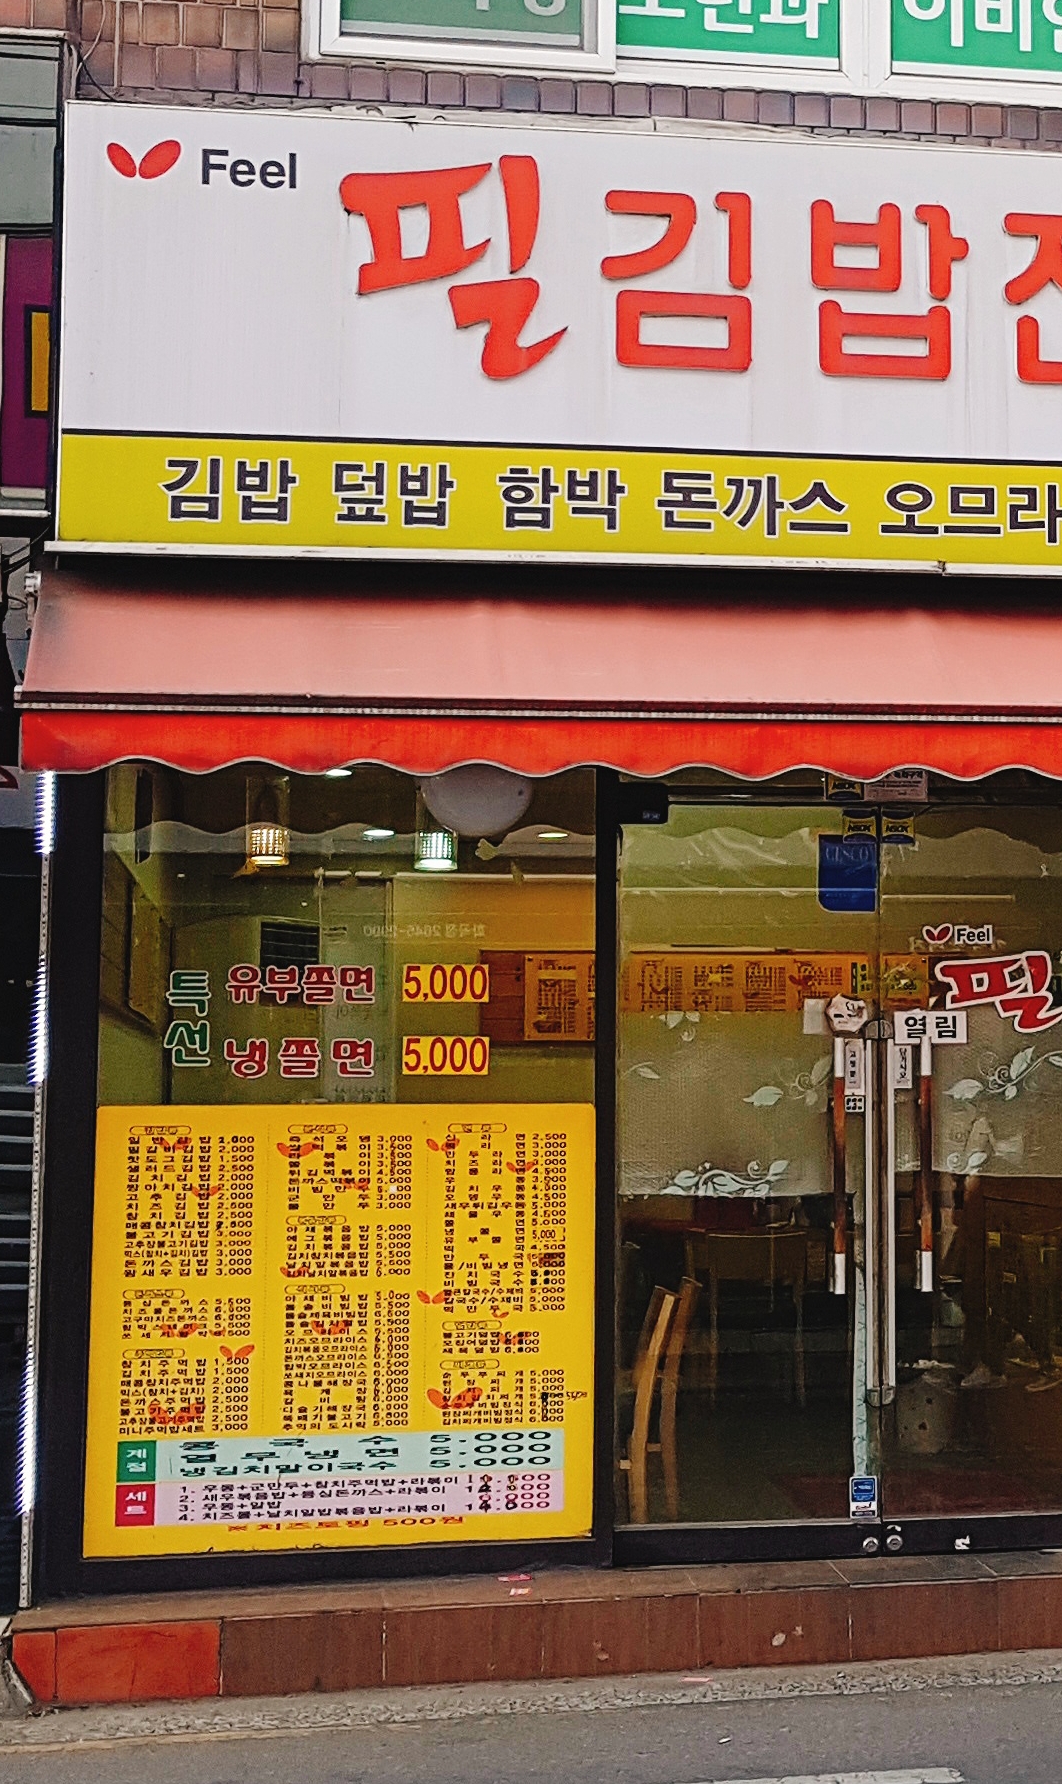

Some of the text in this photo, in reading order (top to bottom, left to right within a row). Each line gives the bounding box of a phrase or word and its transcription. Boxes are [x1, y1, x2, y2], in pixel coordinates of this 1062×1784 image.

[200, 148, 298, 190] Feel
[338, 154, 568, 380] 필
[158, 457, 299, 522] 김밥
[333, 461, 456, 528] 덮밥
[498, 466, 626, 530] 함박
[654, 469, 851, 538] 돈까스
[953, 923, 993, 945] Feel
[225, 964, 376, 1005] 유부쫄면
[404, 964, 488, 1001] 5,000
[905, 1015, 957, 1039] 열림
[224, 1037, 488, 1080] 냉쫄면 5,000
